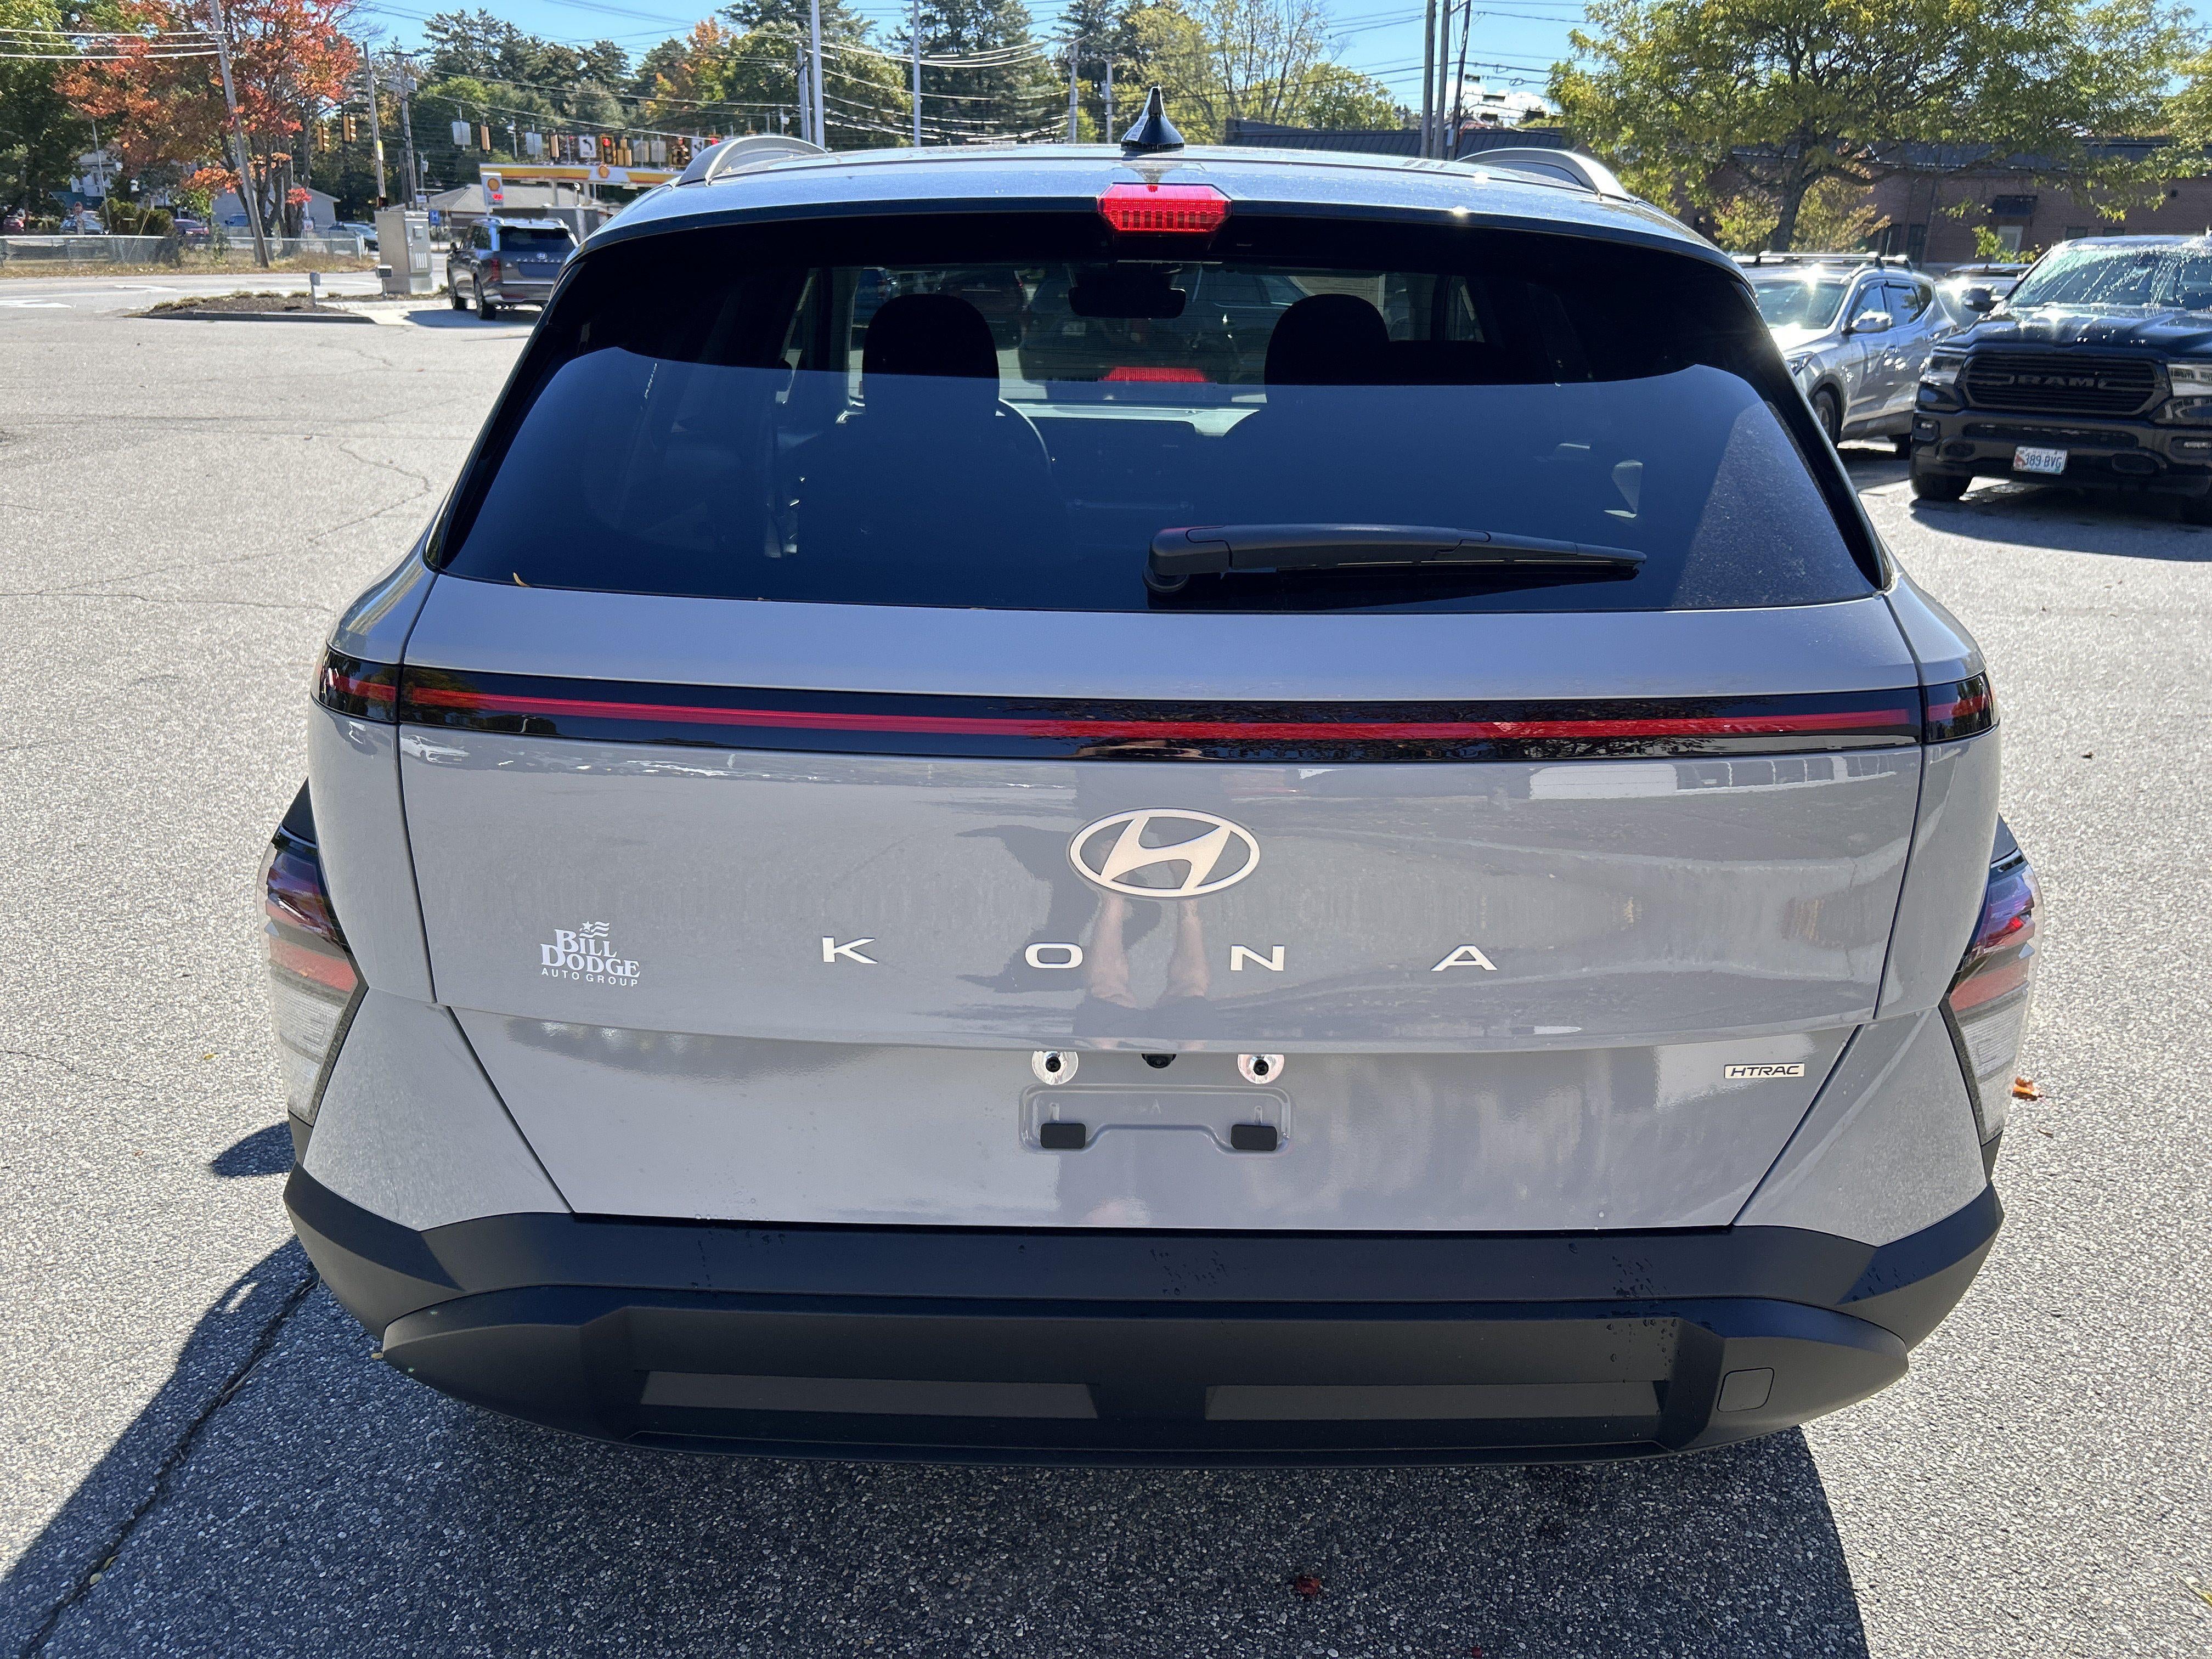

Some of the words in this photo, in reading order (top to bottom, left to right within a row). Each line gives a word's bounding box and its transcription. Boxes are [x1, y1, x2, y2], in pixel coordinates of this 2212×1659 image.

[2018, 376, 2095, 387] RAM
[554, 928, 617, 958] BILL
[822, 935, 1498, 972] KONA
[540, 943, 641, 978] DODGE
[541, 967, 580, 980] AUTO
[586, 973, 638, 987] GROUP
[1730, 1065, 1799, 1076] HTRAC
